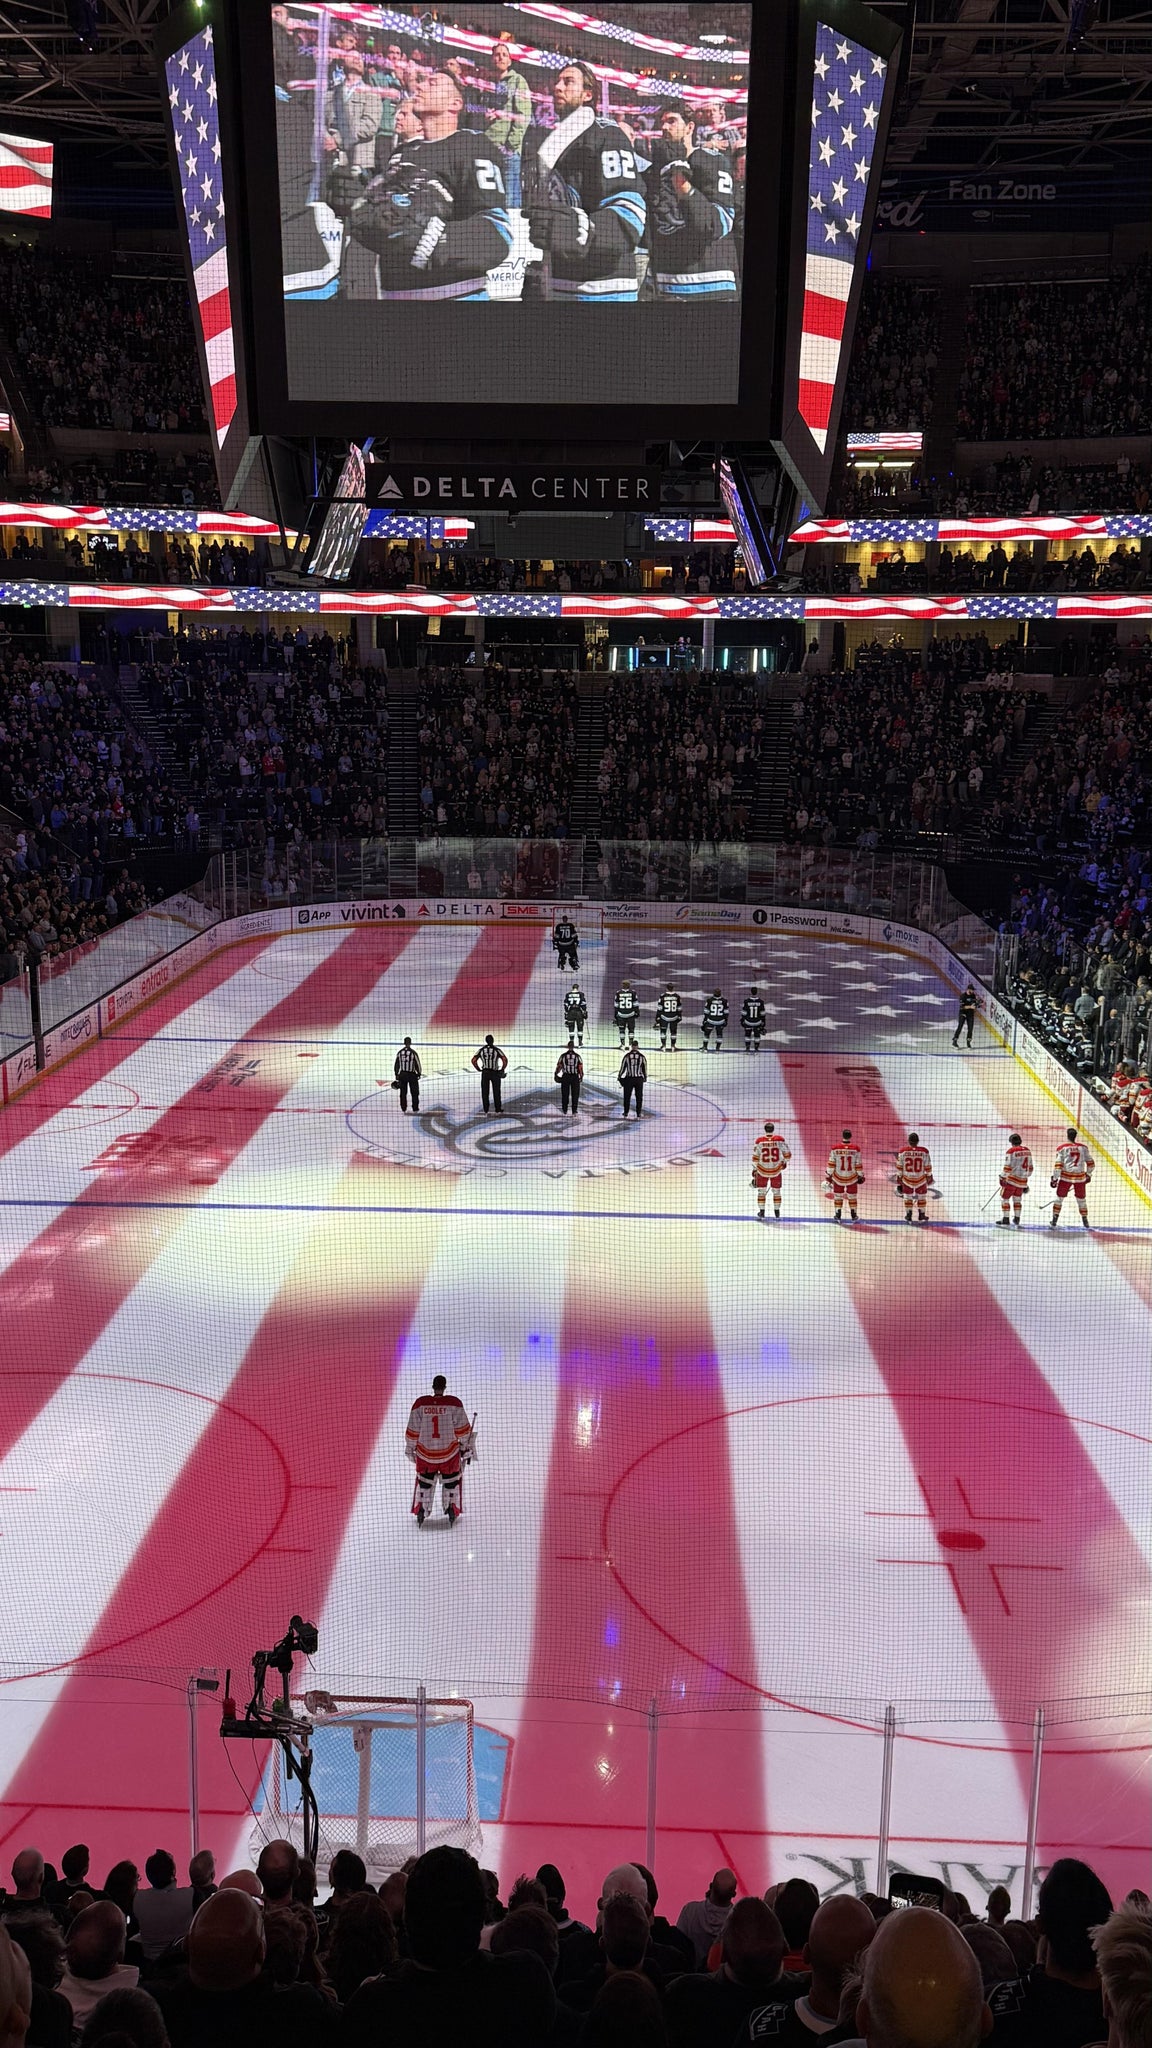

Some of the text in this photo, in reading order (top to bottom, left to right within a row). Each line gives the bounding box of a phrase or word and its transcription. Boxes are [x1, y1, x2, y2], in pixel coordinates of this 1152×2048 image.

[601, 150, 637, 180] 82
[948, 179, 1056, 201] Fan Zone
[413, 477, 649, 499] DELTA CENTER
[310, 910, 331, 921] App
[340, 903, 390, 920] vivint
[436, 904, 495, 916] DELTA
[507, 906, 539, 915] SME
[769, 912, 828, 927] 1Password
[560, 928, 570, 939] 70
[619, 997, 633, 1009] 26
[663, 1001, 678, 1012] 98
[710, 1004, 724, 1016] 92
[749, 1006, 758, 1018] 11
[761, 1147, 780, 1163] 29
[1070, 1152, 1080, 1167] 7
[839, 1155, 853, 1171] 11
[905, 1157, 923, 1173] 20
[1021, 1156, 1029, 1170] 4
[423, 1407, 446, 1415] COOLEY
[431, 1415, 441, 1439] 1
[756, 2006, 784, 2033] UTAH
